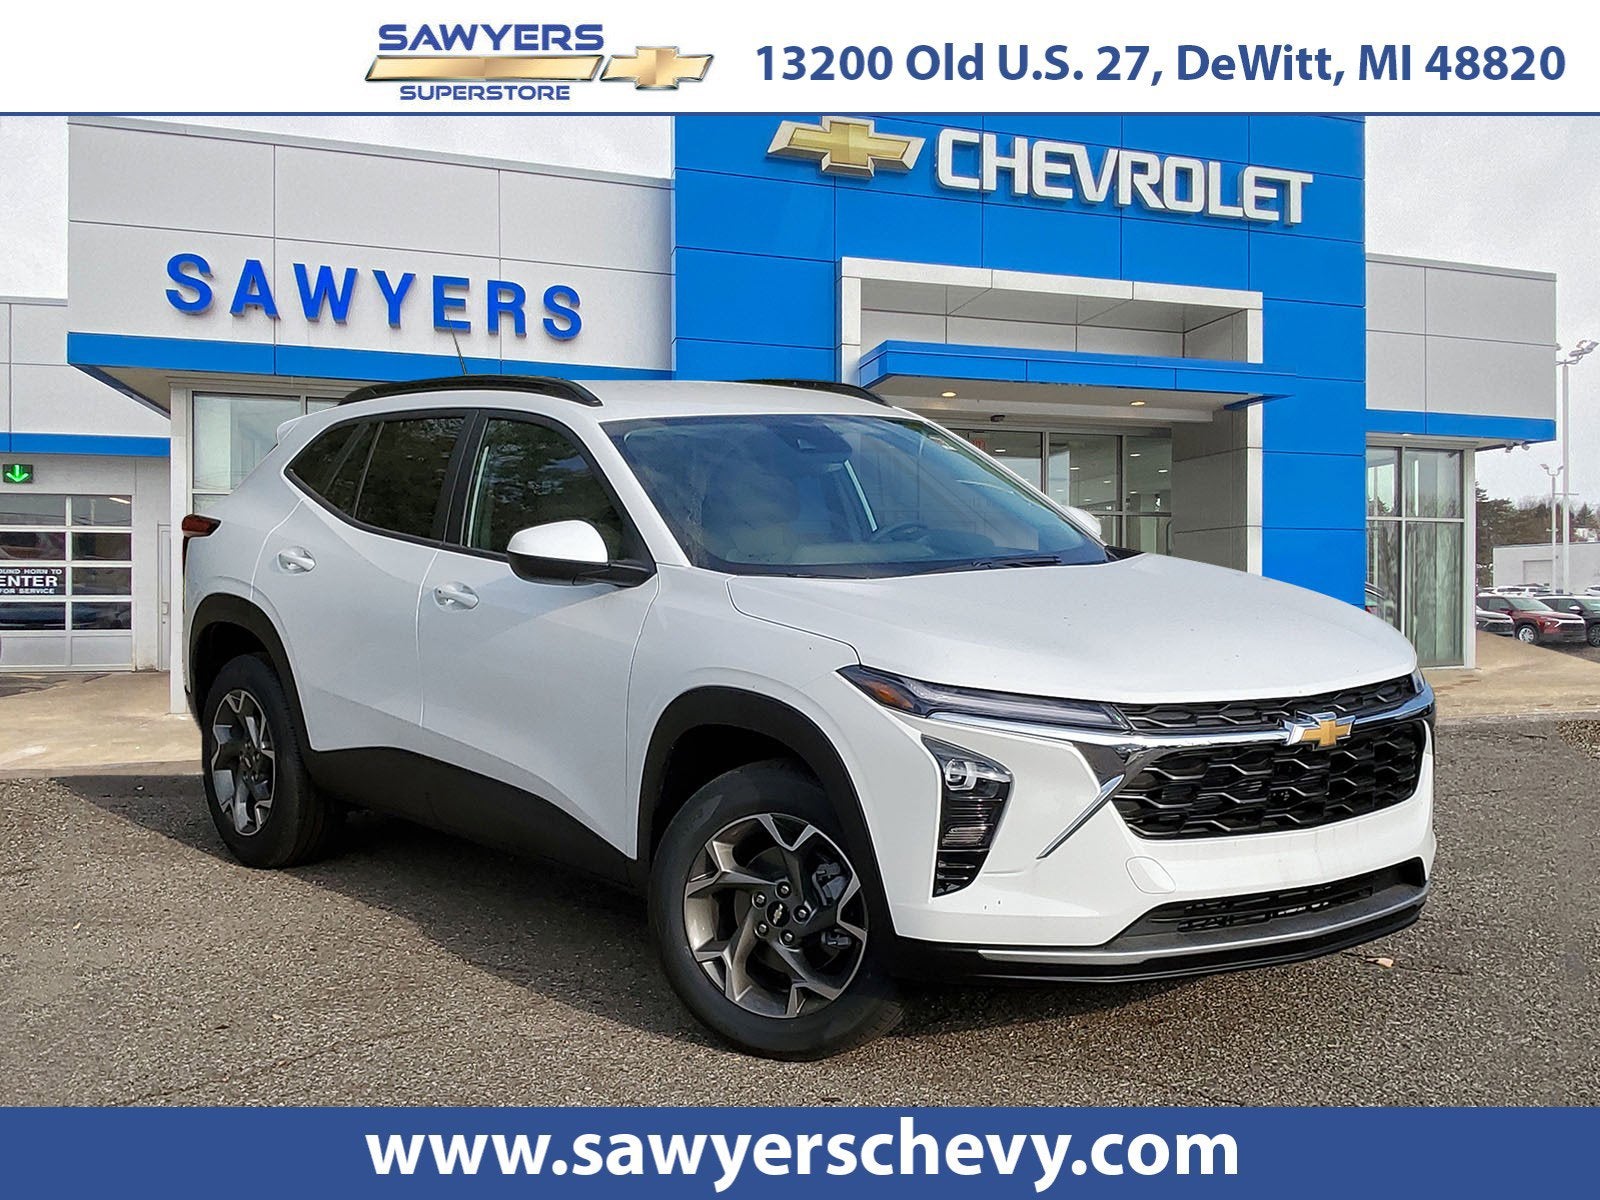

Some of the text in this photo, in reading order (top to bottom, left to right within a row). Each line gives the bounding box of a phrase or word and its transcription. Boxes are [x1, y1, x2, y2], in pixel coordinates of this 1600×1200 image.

[936, 128, 1314, 225] CHEVROLET
[165, 252, 583, 342] SAWYERS
[0, 575, 58, 587] ENTER
